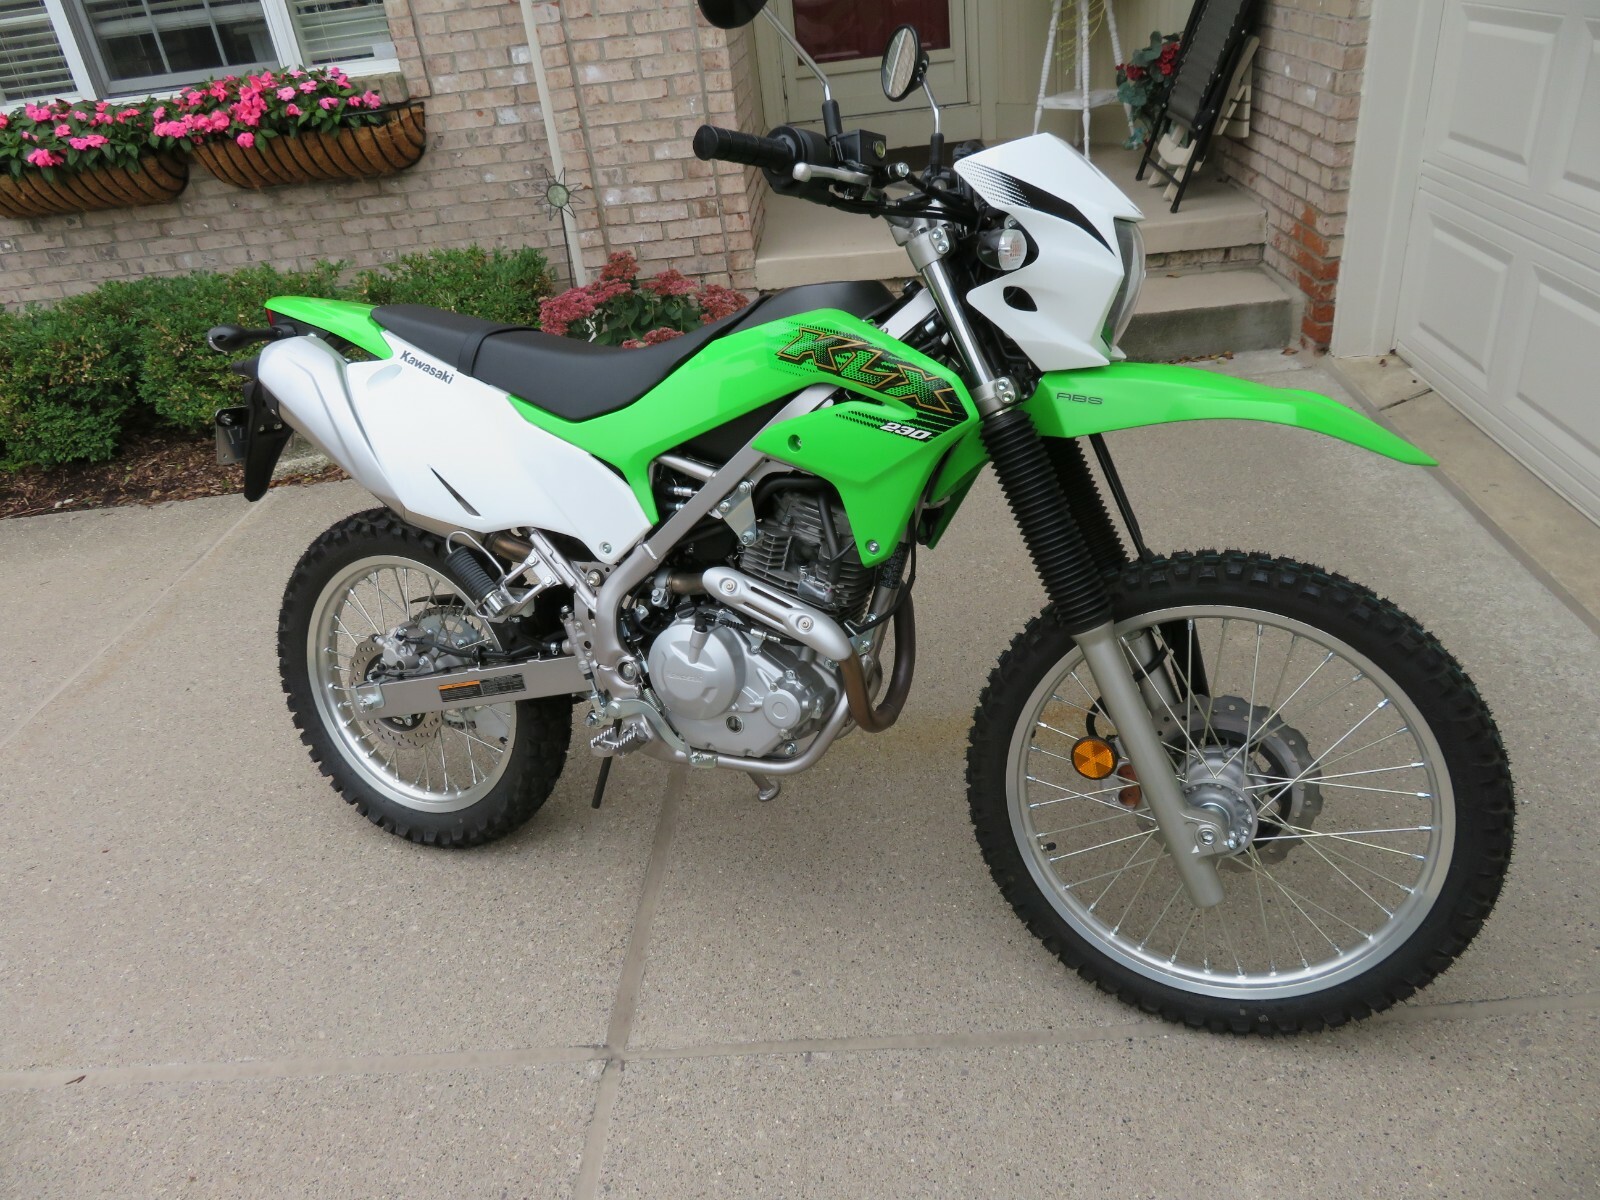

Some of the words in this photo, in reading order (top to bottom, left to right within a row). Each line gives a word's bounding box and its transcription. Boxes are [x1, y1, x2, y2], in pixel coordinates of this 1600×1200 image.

[400, 350, 454, 384] Kawasaki
[777, 327, 954, 414] KLX
[1056, 392, 1103, 405] ABS
[880, 422, 932, 440] 230
